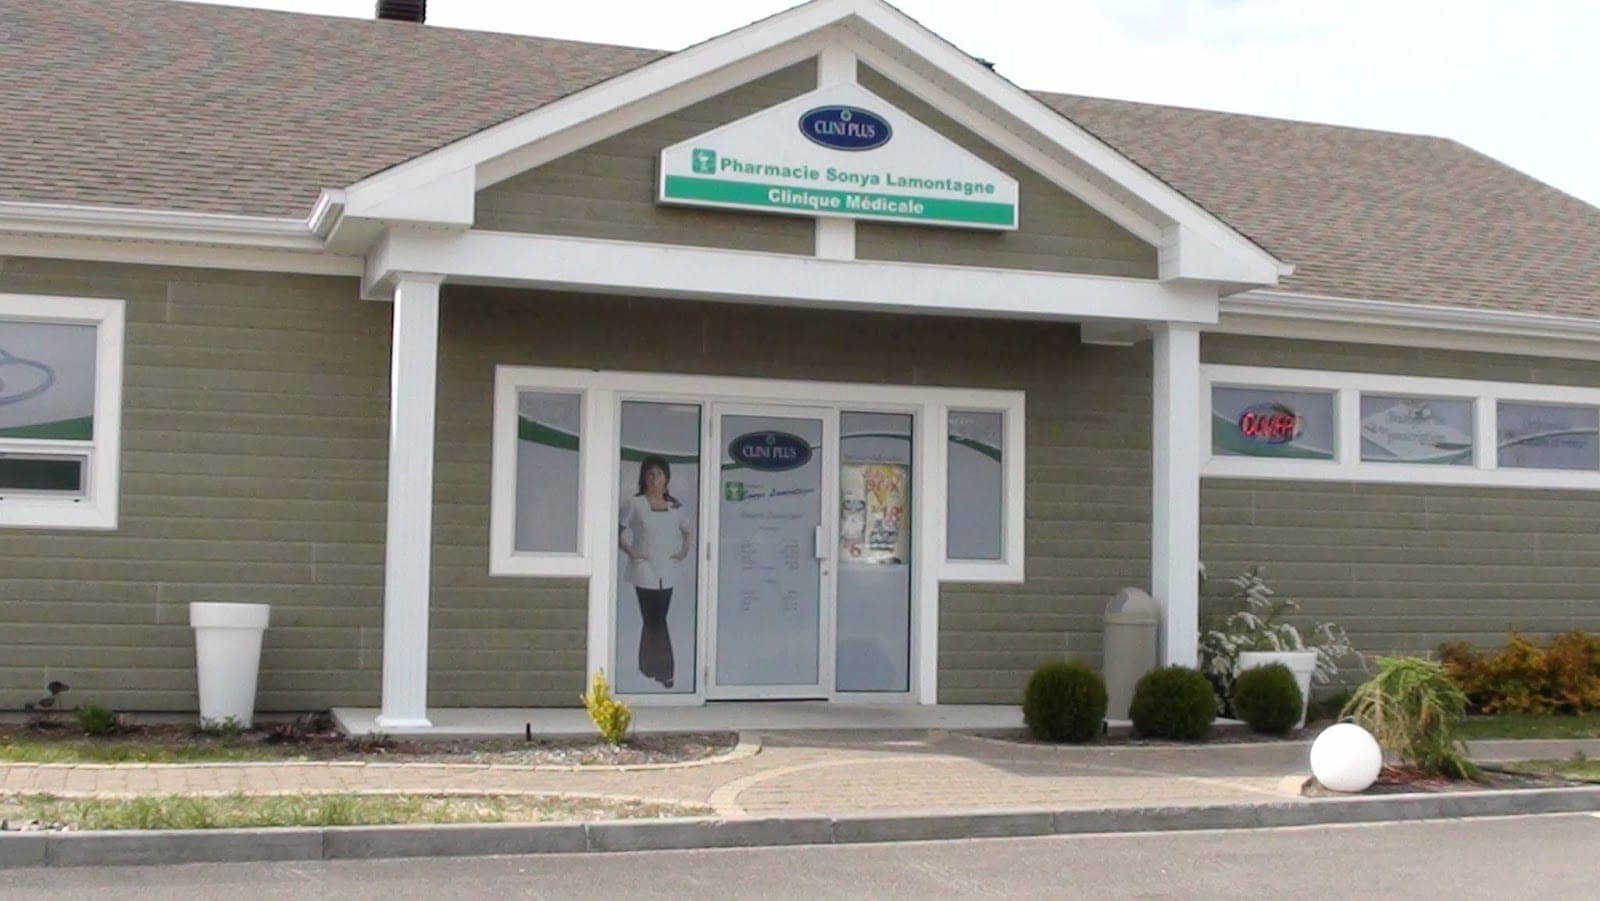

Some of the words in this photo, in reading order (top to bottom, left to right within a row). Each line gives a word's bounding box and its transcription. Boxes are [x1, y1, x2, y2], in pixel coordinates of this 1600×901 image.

[814, 121, 847, 136] CLINI
[847, 122, 876, 138] PLUS
[720, 157, 821, 181] Pharmacie
[826, 167, 881, 187] Sonya
[886, 173, 996, 196] Lamontagne
[768, 188, 841, 210] Clinique
[846, 192, 925, 215] Médicale
